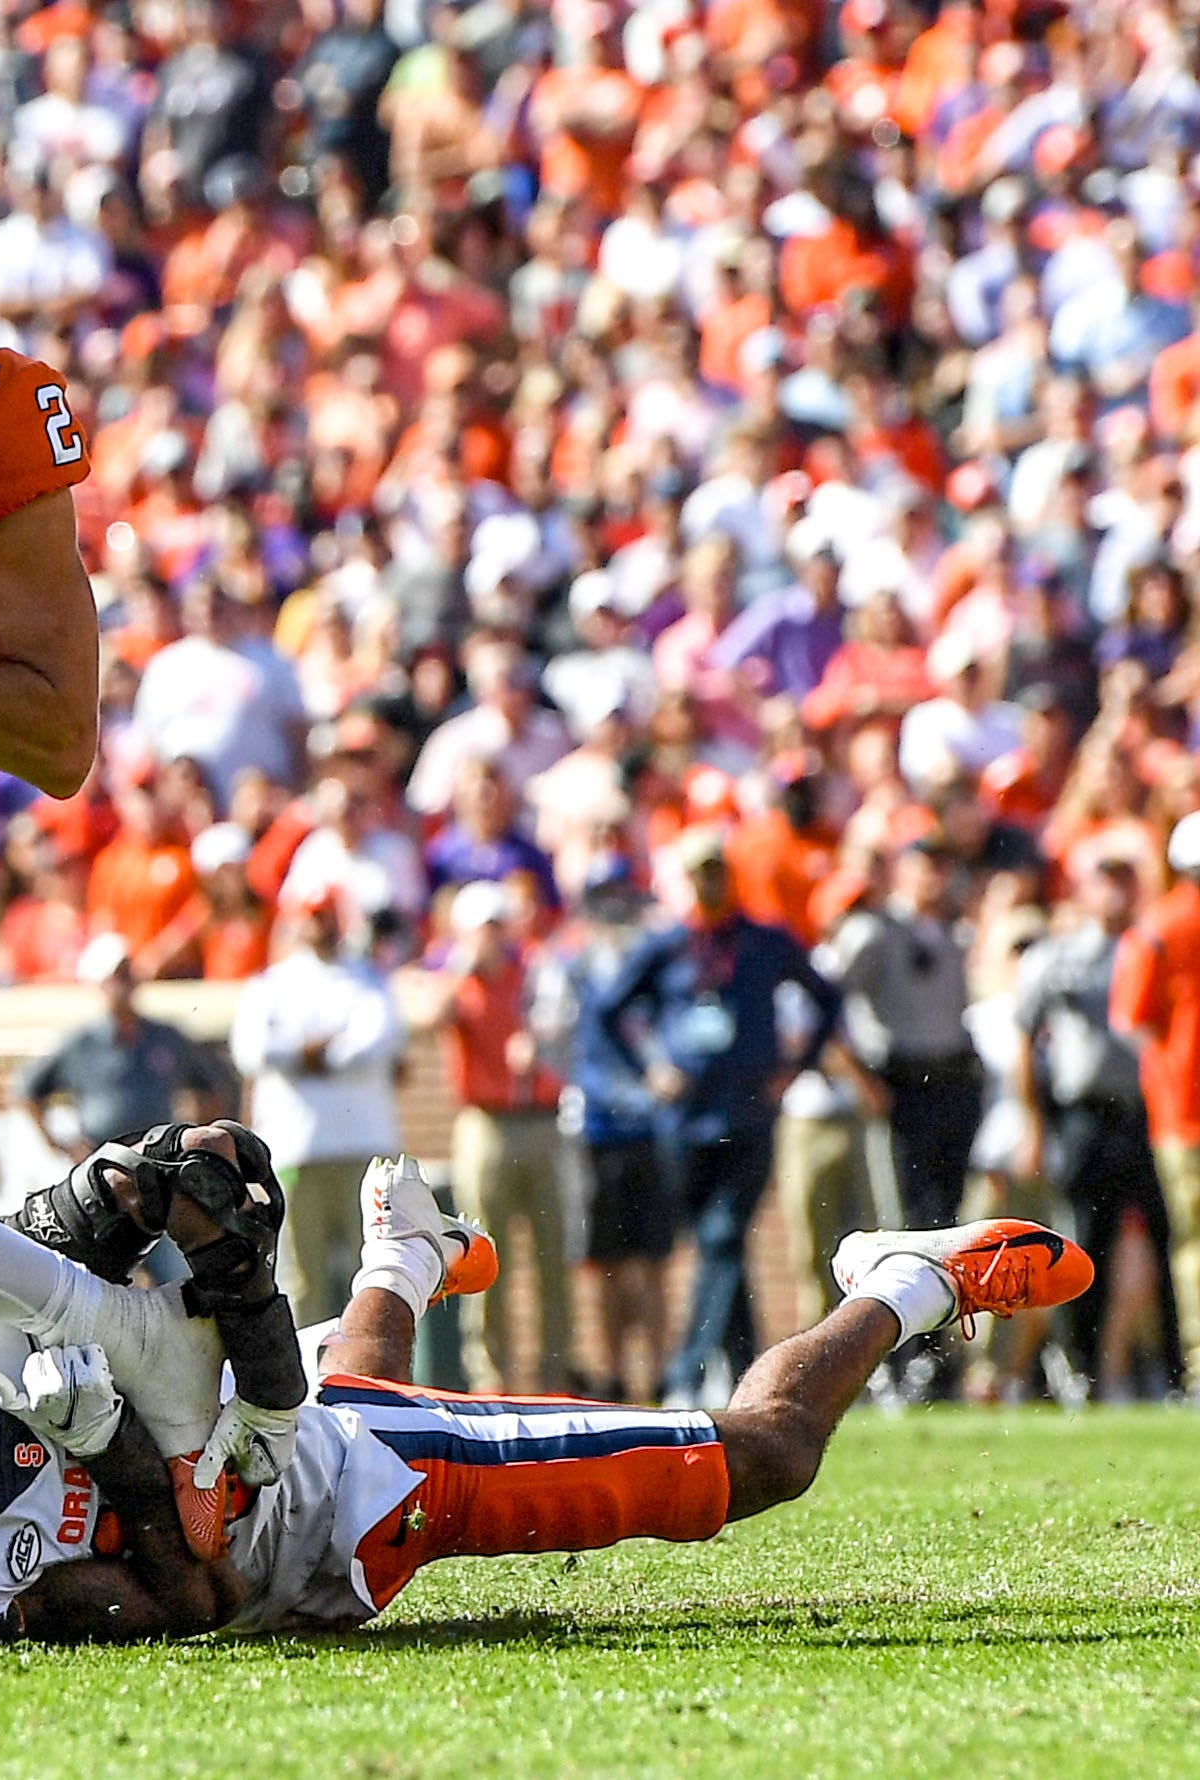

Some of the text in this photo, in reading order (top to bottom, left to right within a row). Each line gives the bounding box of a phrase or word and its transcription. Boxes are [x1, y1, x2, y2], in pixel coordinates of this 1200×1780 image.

[35, 382, 83, 467] 2
[14, 1443, 44, 1468] S
[56, 1451, 93, 1545] ORA
[13, 1530, 36, 1574] ACC
